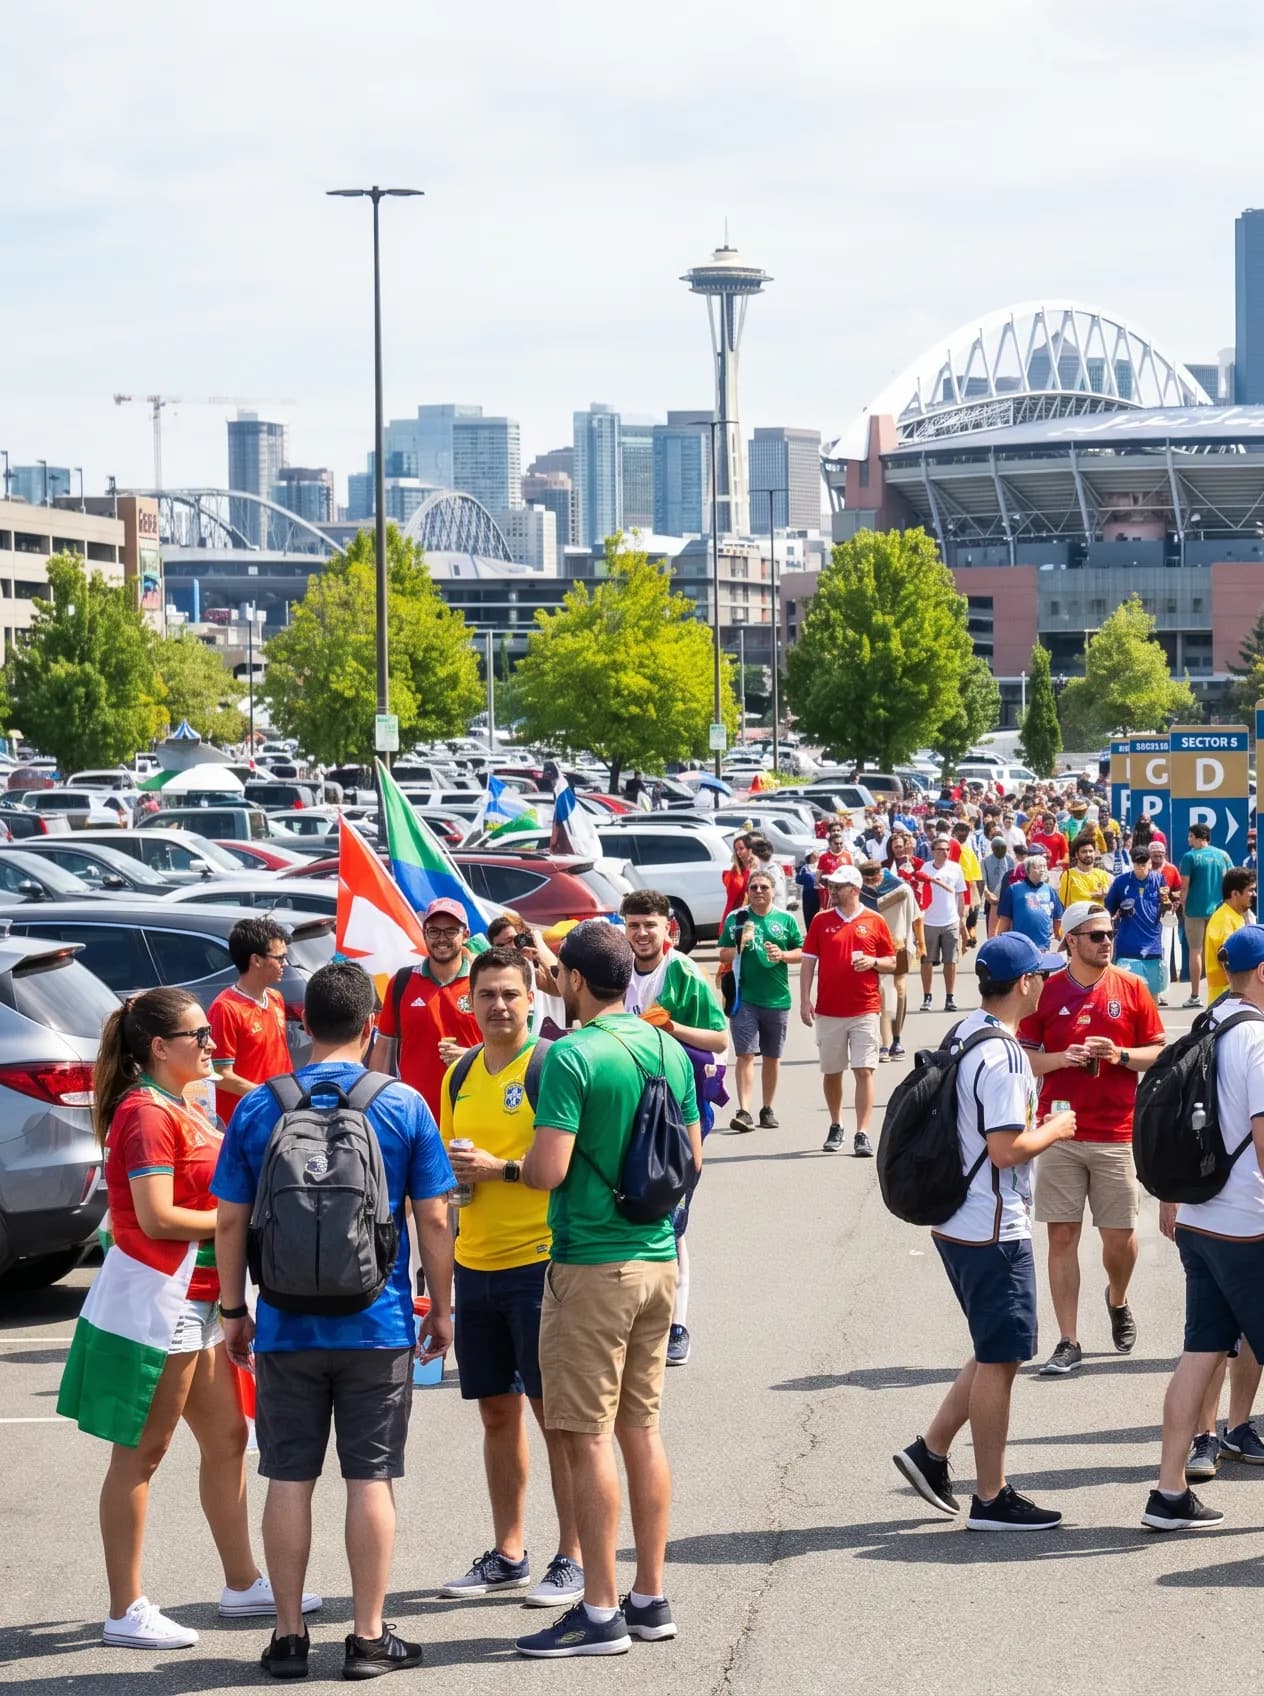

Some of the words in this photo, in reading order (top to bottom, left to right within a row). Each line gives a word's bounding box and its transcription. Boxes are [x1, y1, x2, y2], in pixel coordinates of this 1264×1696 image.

[1181, 737, 1228, 747] SECTOR
[1145, 758, 1169, 785] G
[1195, 757, 1225, 791] D
